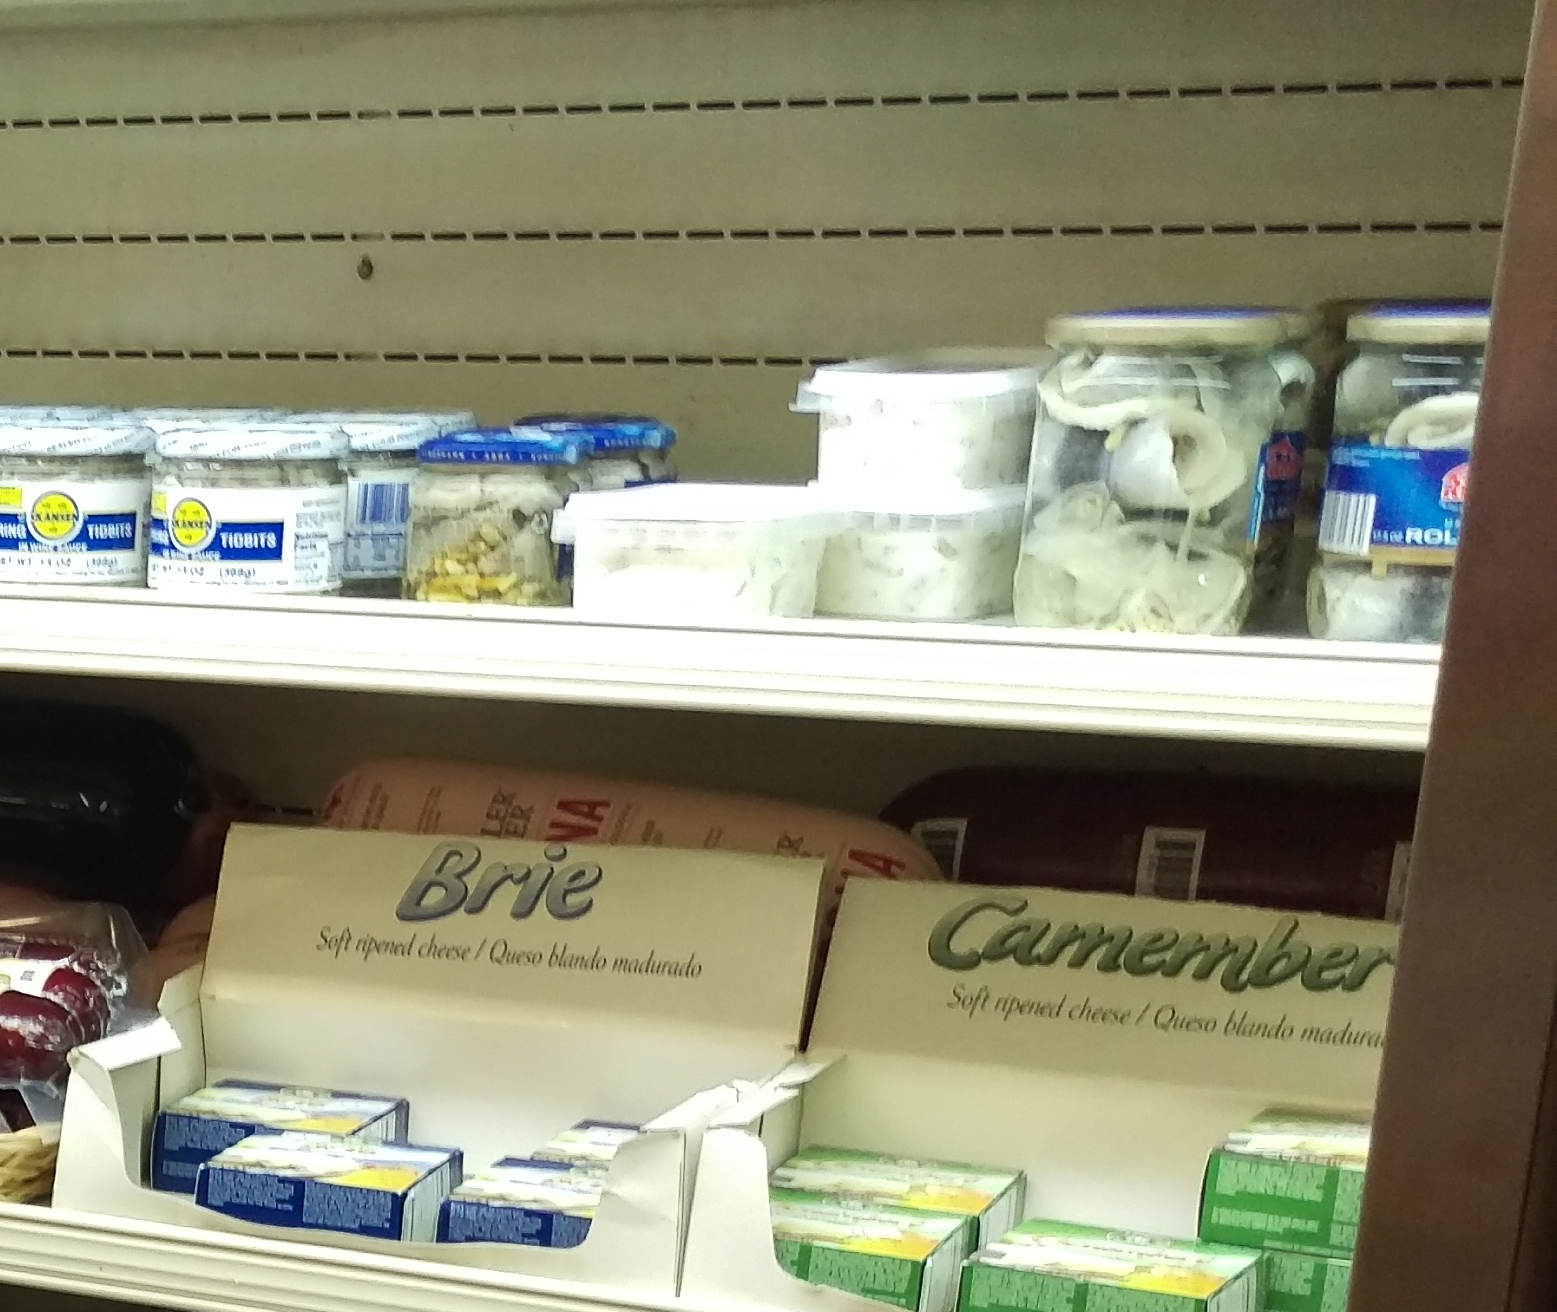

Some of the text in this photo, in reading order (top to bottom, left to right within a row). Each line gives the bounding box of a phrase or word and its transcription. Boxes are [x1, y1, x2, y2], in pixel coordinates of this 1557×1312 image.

[87, 522, 133, 539] TIDBITS
[219, 531, 277, 549] TIDBITS
[396, 841, 604, 922] Brie
[316, 926, 351, 961] Soft
[355, 932, 417, 962] ripened
[418, 934, 472, 962] cheese
[489, 939, 544, 967] Queso
[548, 942, 608, 972] blando
[612, 949, 703, 980] madurado
[928, 897, 1397, 994] Camember
[947, 983, 989, 1020] Soft
[994, 993, 1067, 1022] ripened
[1069, 995, 1132, 1026] cheese
[1154, 1003, 1217, 1033] Queso
[1224, 1008, 1294, 1041] blando
